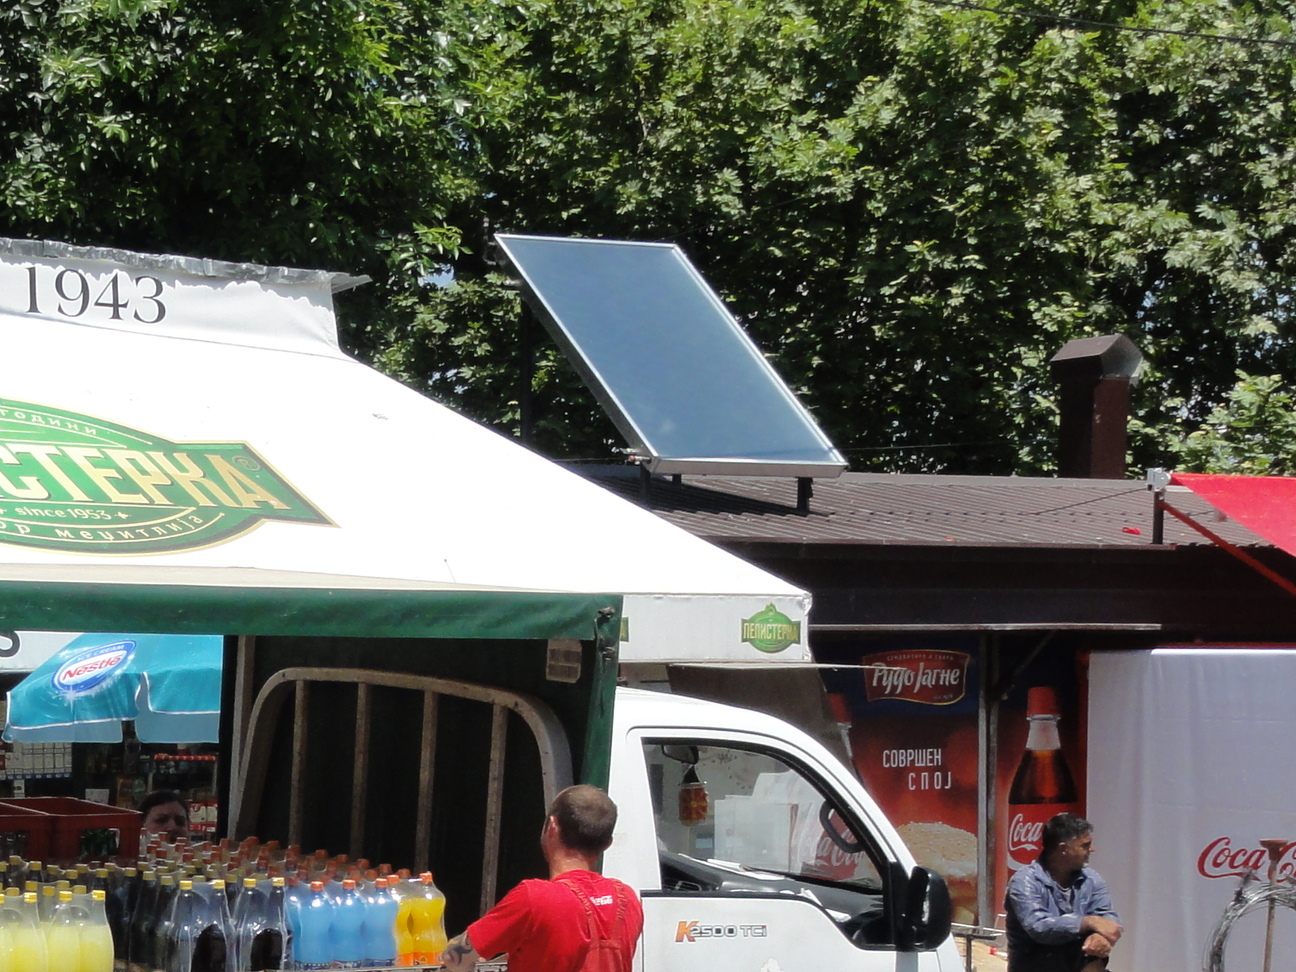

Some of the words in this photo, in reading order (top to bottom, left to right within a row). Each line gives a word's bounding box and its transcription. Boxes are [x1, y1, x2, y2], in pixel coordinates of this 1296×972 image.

[25, 266, 166, 324] 1943
[14, 506, 67, 519] since
[70, 508, 112, 520] 1953
[882, 748, 942, 768] СОВРШЕН
[908, 771, 952, 790] СПОЈ
